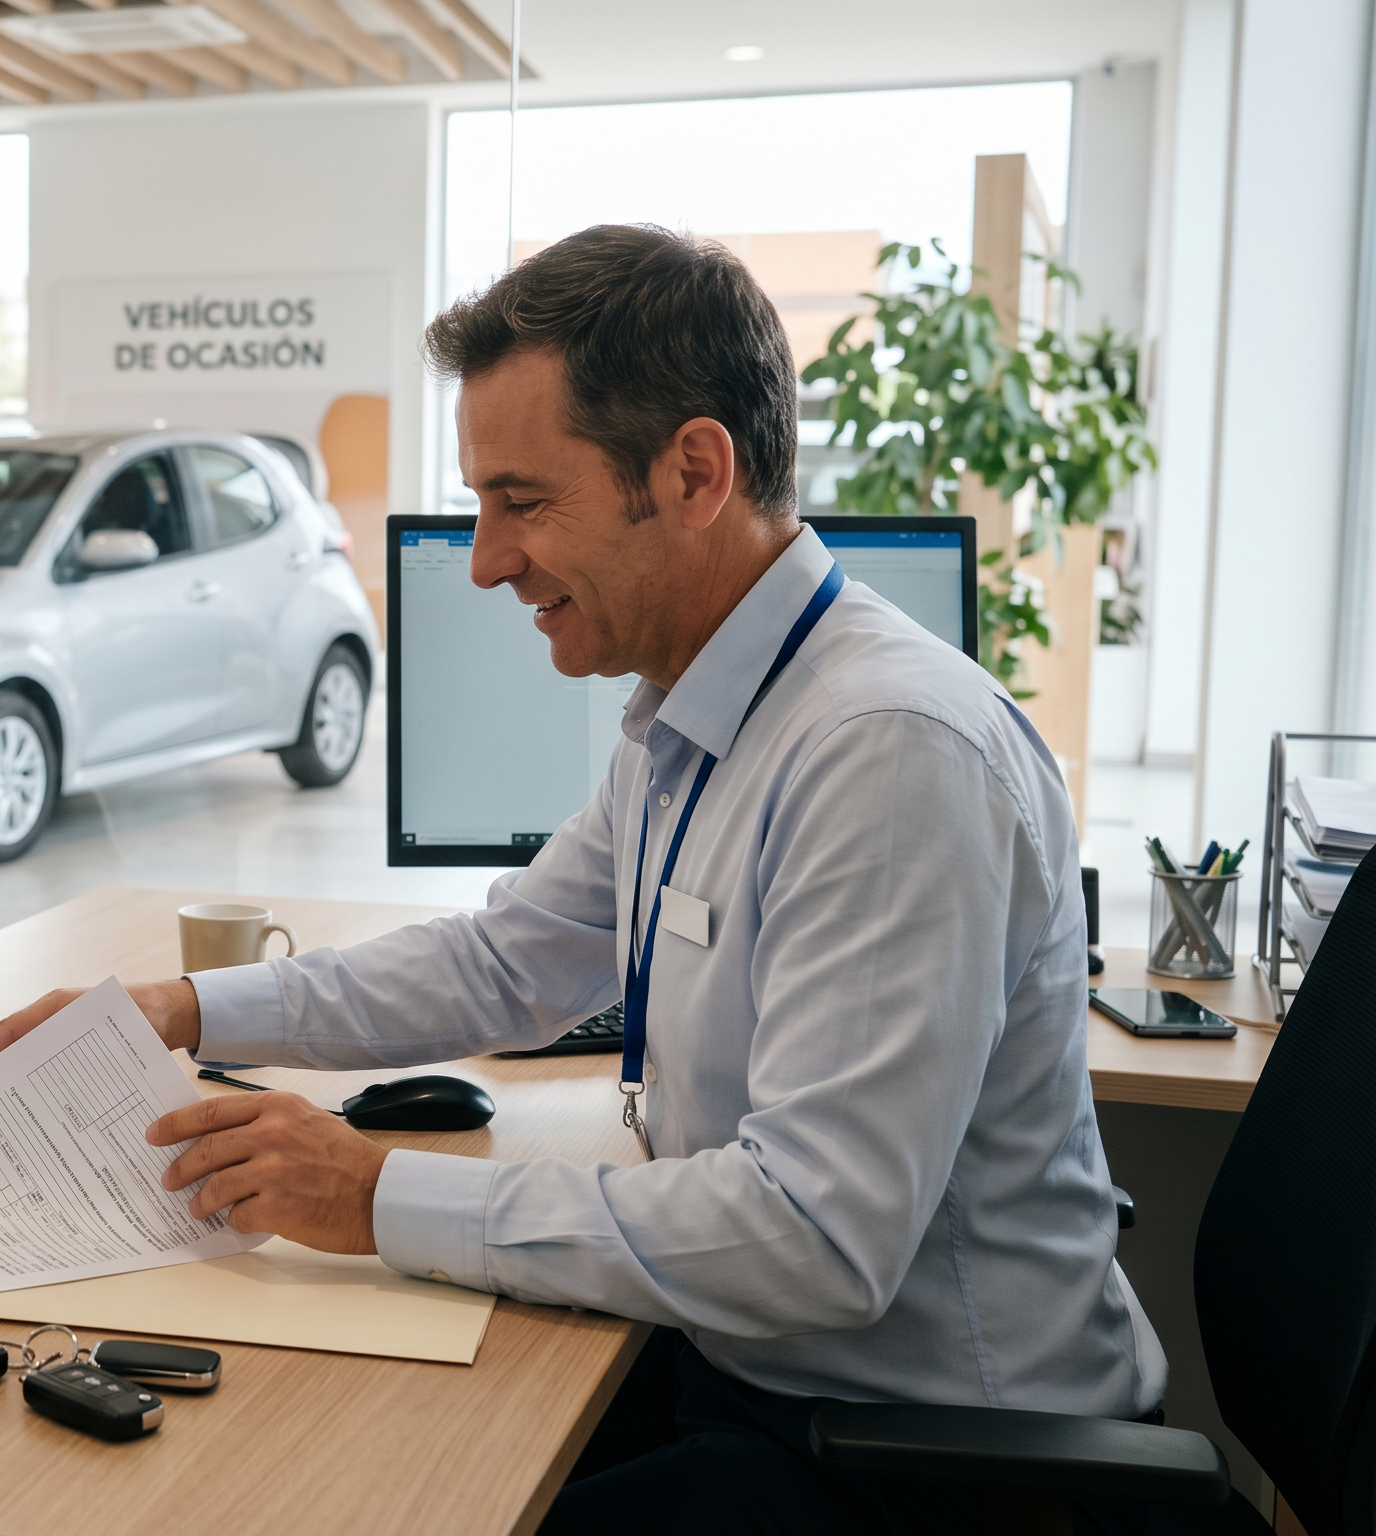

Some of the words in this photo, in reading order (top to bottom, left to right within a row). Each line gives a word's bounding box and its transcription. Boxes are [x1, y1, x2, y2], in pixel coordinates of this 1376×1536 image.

[123, 294, 315, 330] VEHÍCULOS
[114, 343, 157, 371] DE
[167, 334, 326, 371] OCASIÓN
